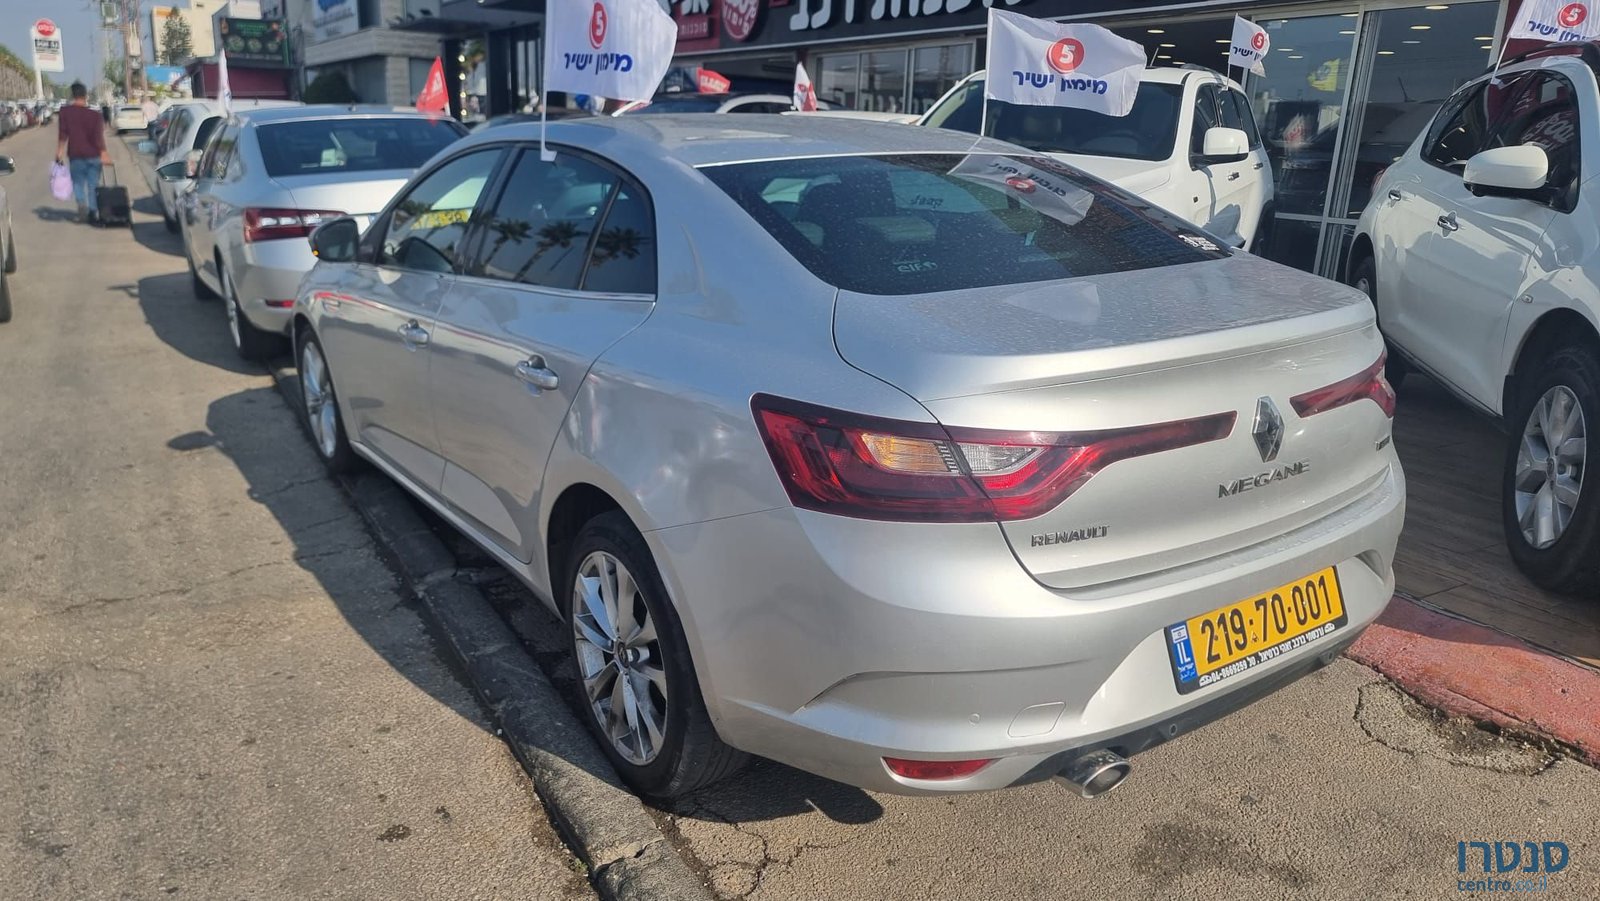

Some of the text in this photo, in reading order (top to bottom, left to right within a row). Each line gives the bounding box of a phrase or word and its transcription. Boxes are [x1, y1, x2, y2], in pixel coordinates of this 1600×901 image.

[595, 10, 604, 36] 5
[1565, 7, 1581, 22] 5
[1528, 20, 1558, 35] ישיר
[1232, 46, 1253, 57] ישיר
[1255, 35, 1264, 46] 5
[564, 52, 633, 75] מימון ישיר
[1059, 44, 1076, 64] 5
[1012, 71, 1107, 95] מימון ישיר
[1218, 460, 1310, 498] MEGANE
[1031, 525, 1110, 547] RENAULT
[1291, 634, 1307, 648] ברכב
[1176, 641, 1191, 665] IL
[1211, 659, 1248, 683] 04-8669259
